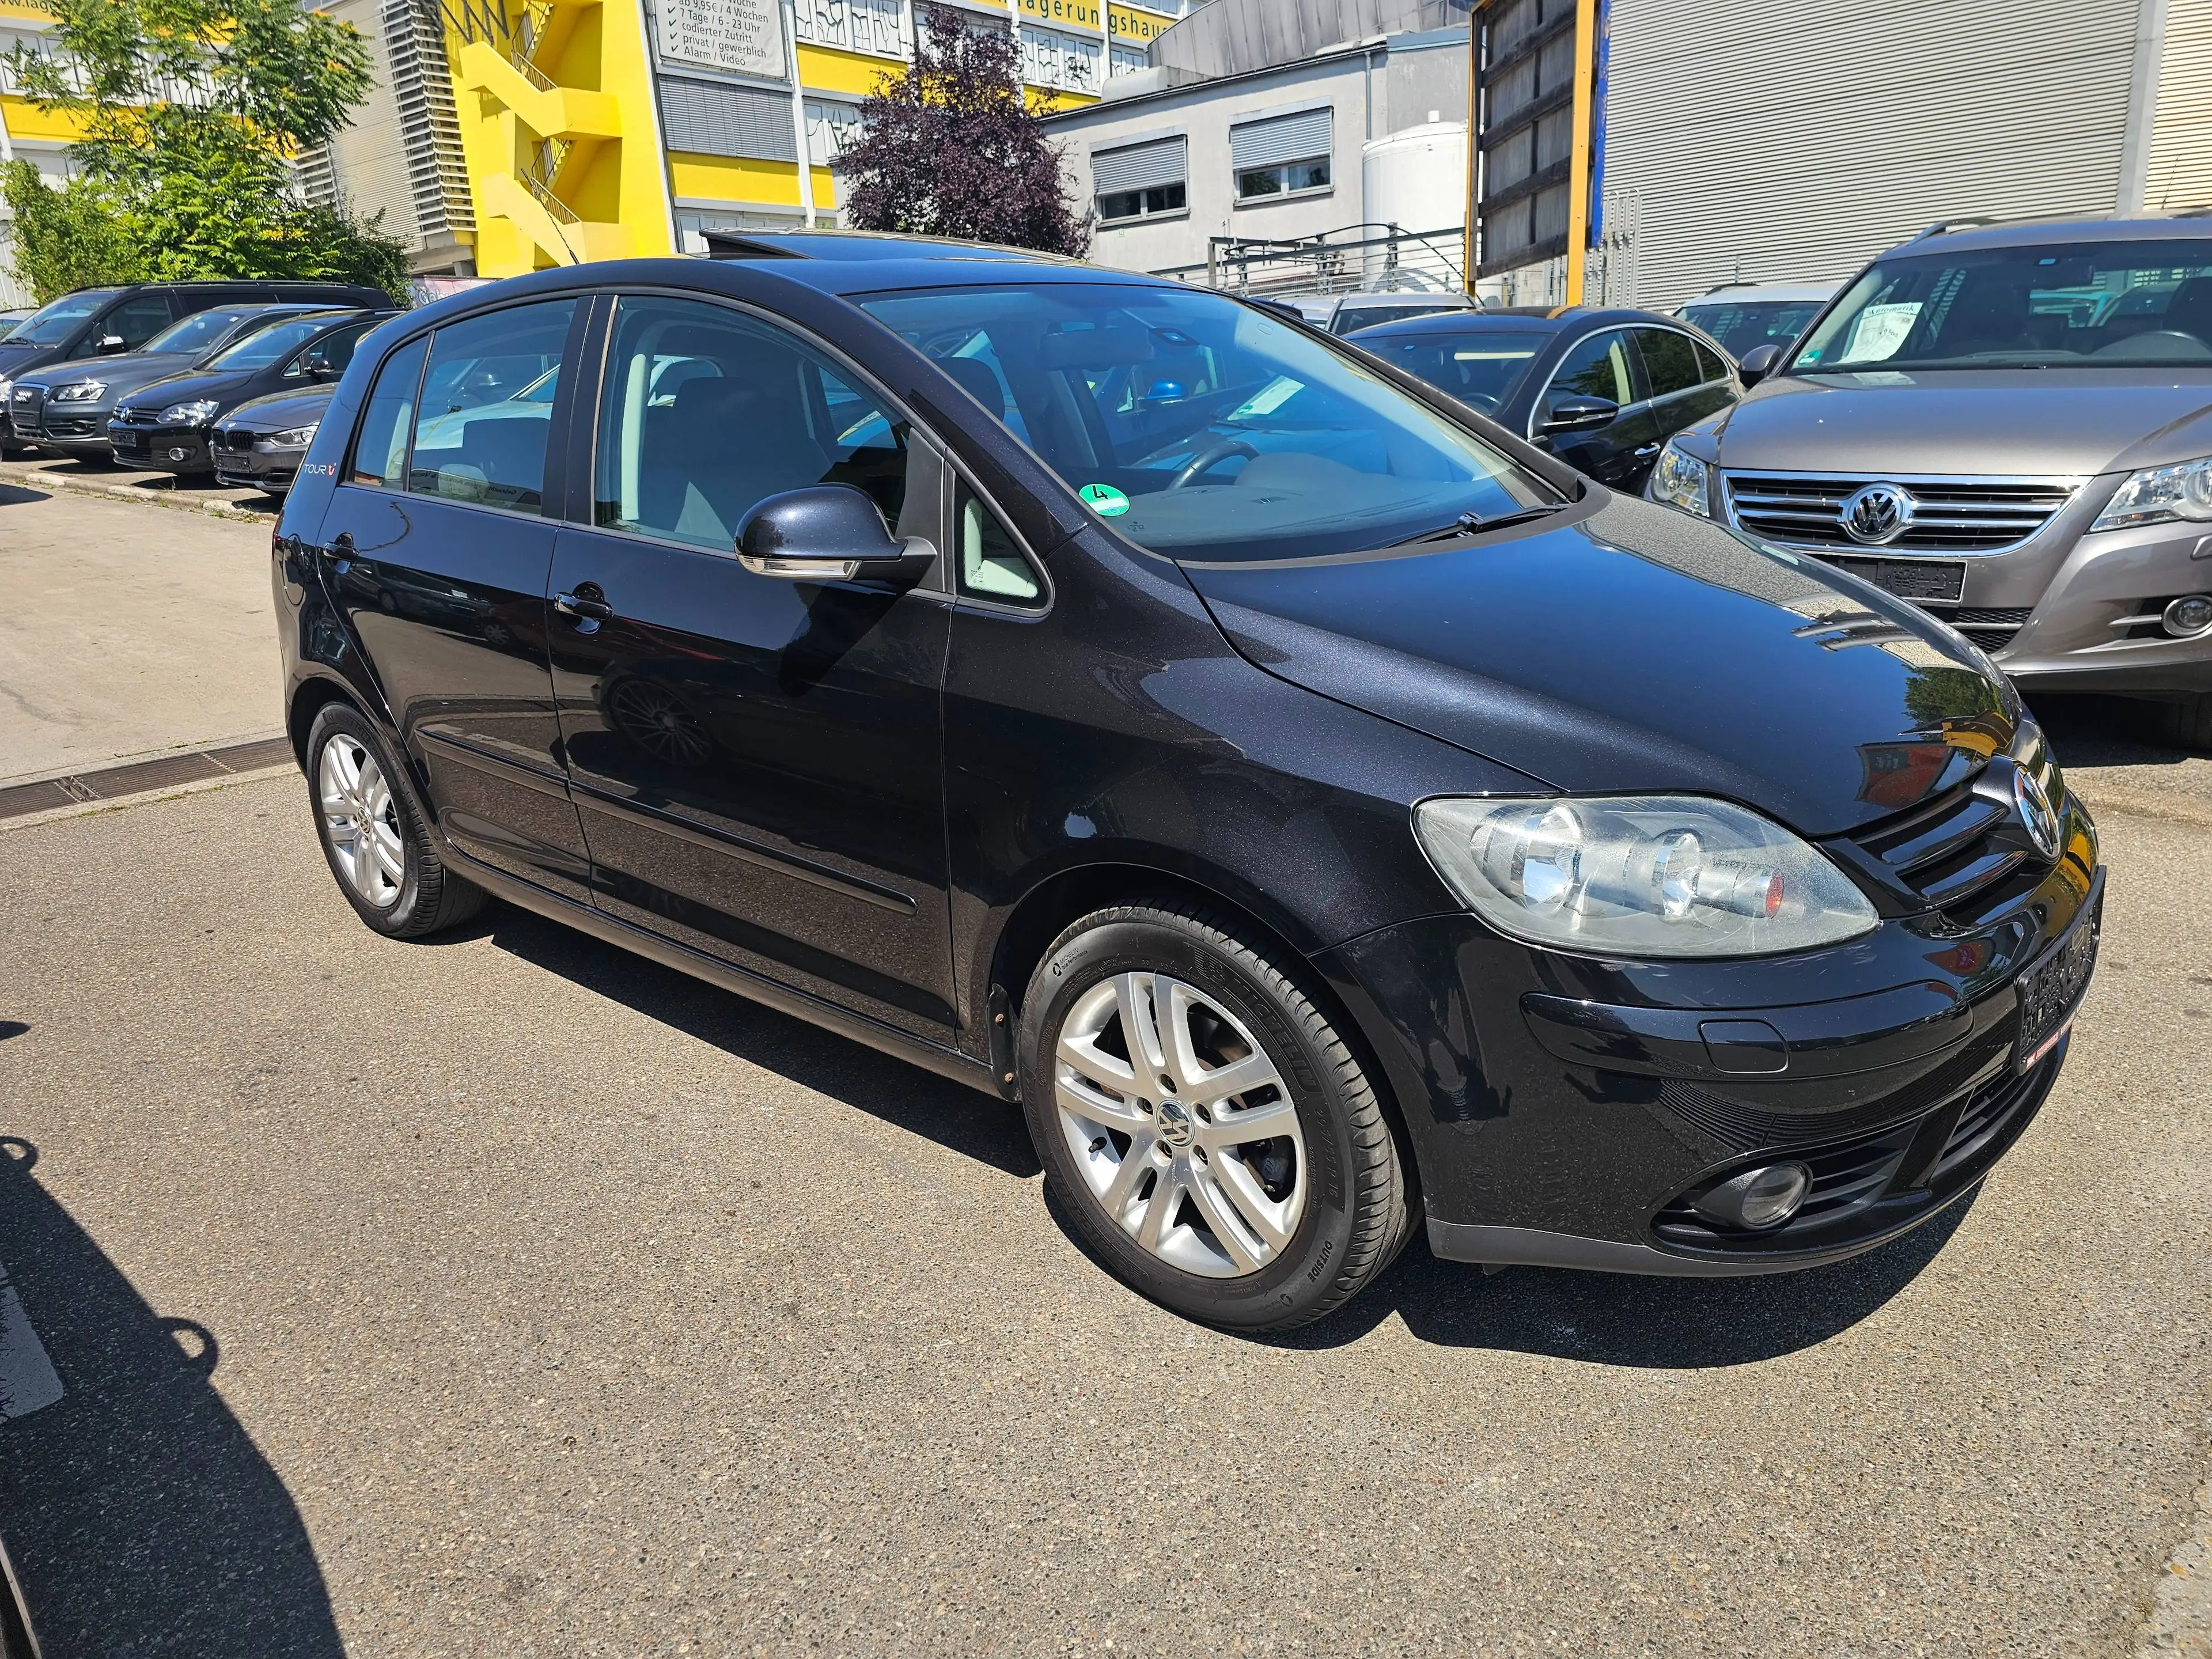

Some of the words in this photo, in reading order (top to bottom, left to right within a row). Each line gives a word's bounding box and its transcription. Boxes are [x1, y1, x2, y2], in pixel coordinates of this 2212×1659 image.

[679, 8, 685, 17] 7
[687, 9, 709, 24] Tage
[718, 16, 724, 26] 6
[732, 18, 742, 29] 23
[744, 21, 760, 33] Uhr
[726, 6, 732, 16] 4
[733, 6, 769, 23] Wochen
[682, 22, 722, 37] codierter
[725, 29, 753, 44] Zutritt
[683, 34, 709, 48] privat
[718, 41, 767, 58] gewerblich
[684, 46, 711, 60] Alarm
[720, 52, 745, 66] Video
[304, 464, 327, 475] TOUR
[1092, 486, 1108, 499] 4
[1226, 978, 1317, 1088] MICHELIN
[1306, 1240, 1334, 1283] OUTSIDE
